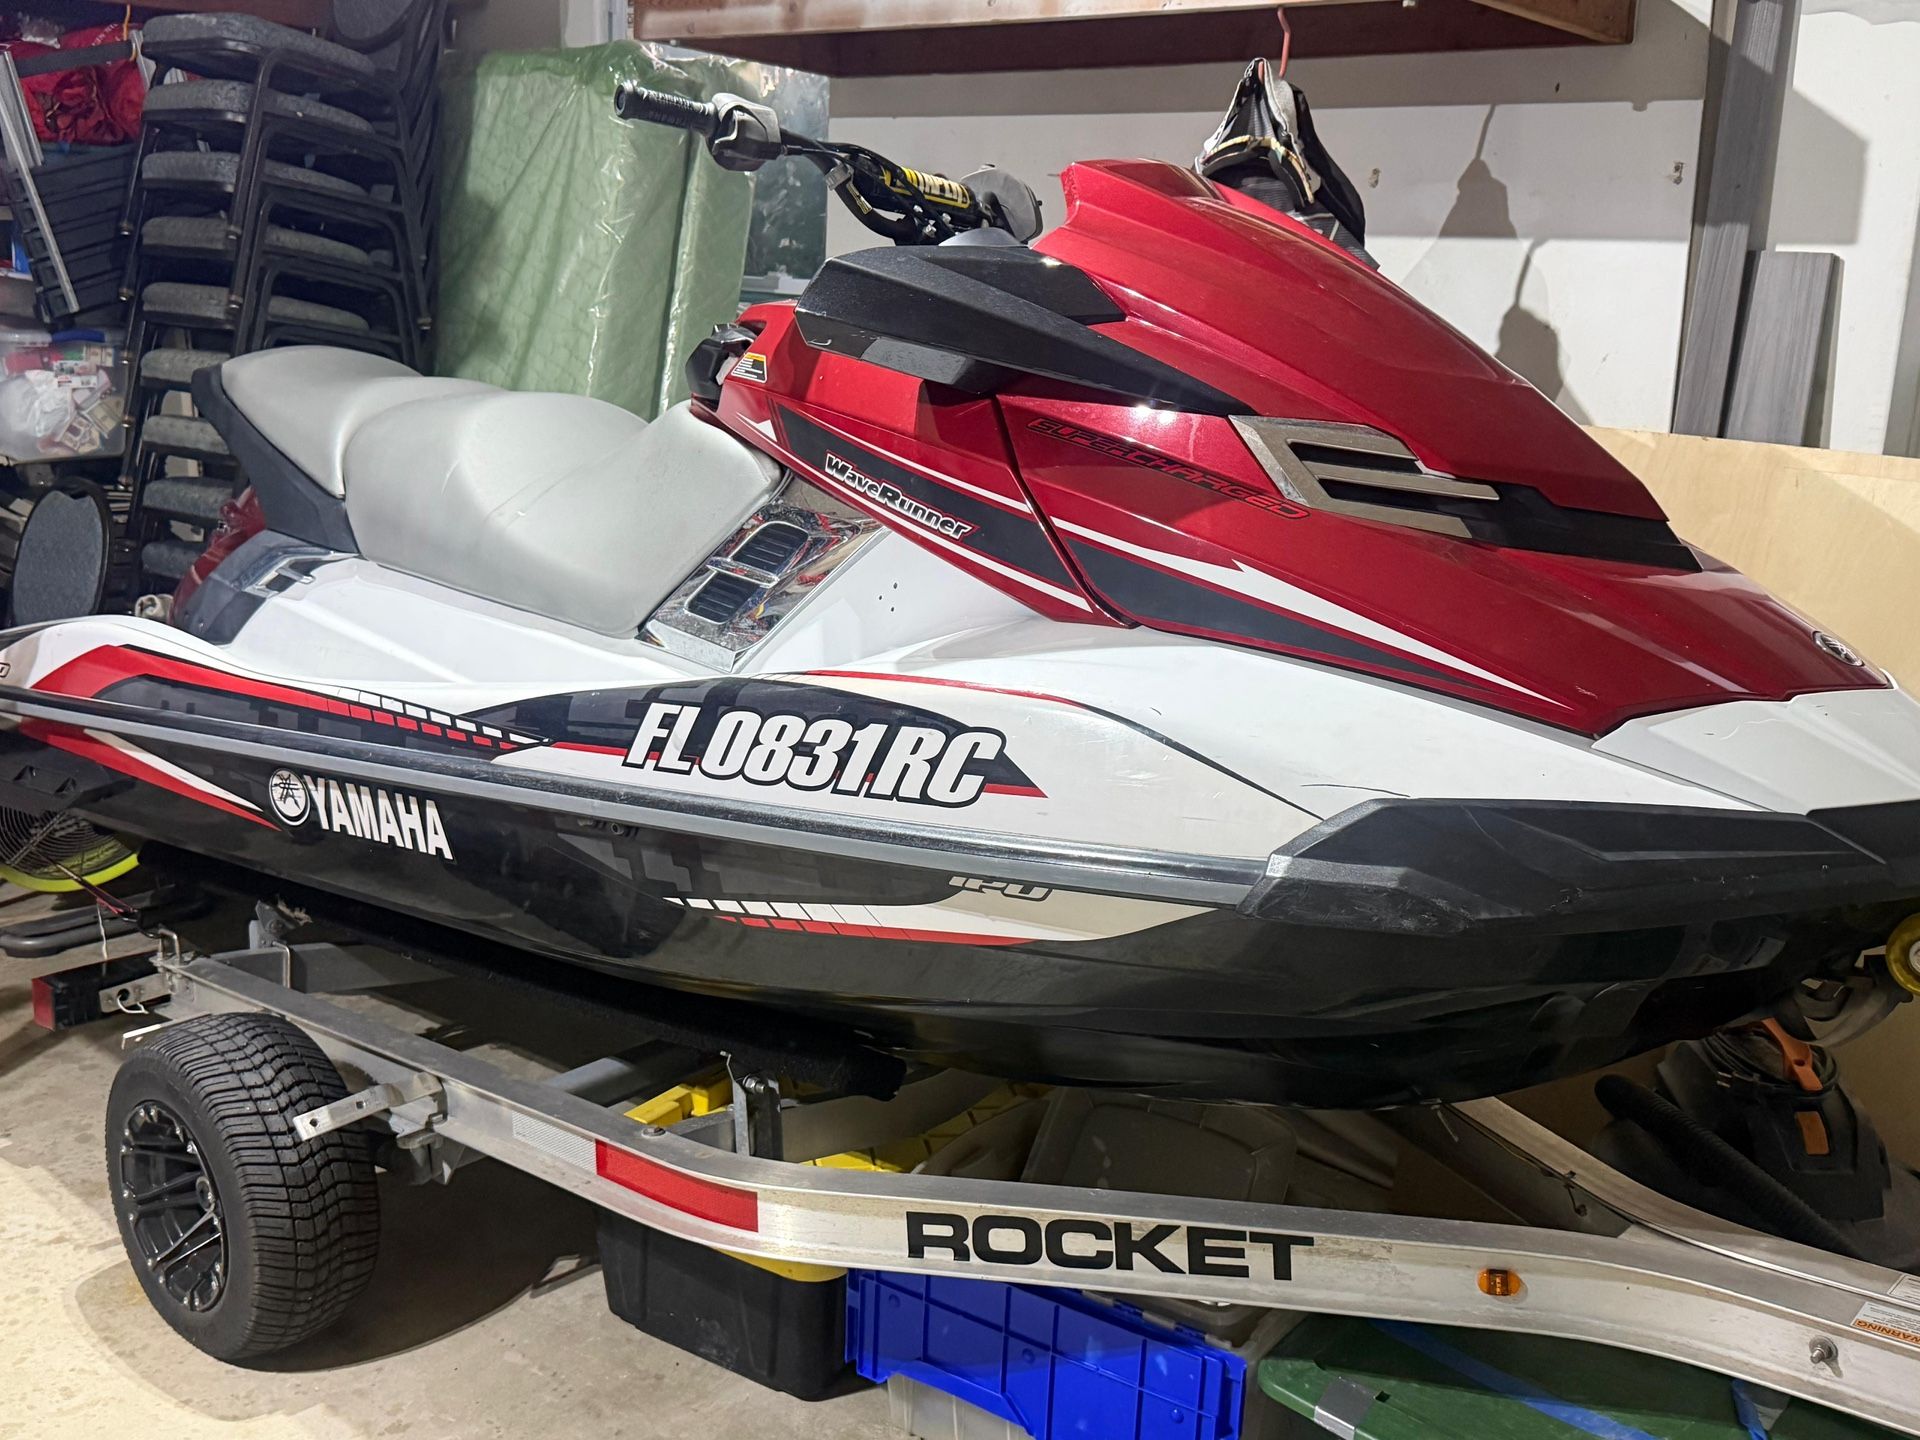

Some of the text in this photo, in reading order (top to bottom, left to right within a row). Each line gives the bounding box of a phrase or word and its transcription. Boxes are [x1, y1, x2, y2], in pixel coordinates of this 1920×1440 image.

[825, 453, 973, 539] WaveRunner
[1026, 418, 1310, 519] SUPERCHARGED
[303, 774, 454, 860] YAMAHA
[906, 1211, 1314, 1281] ROCKET
